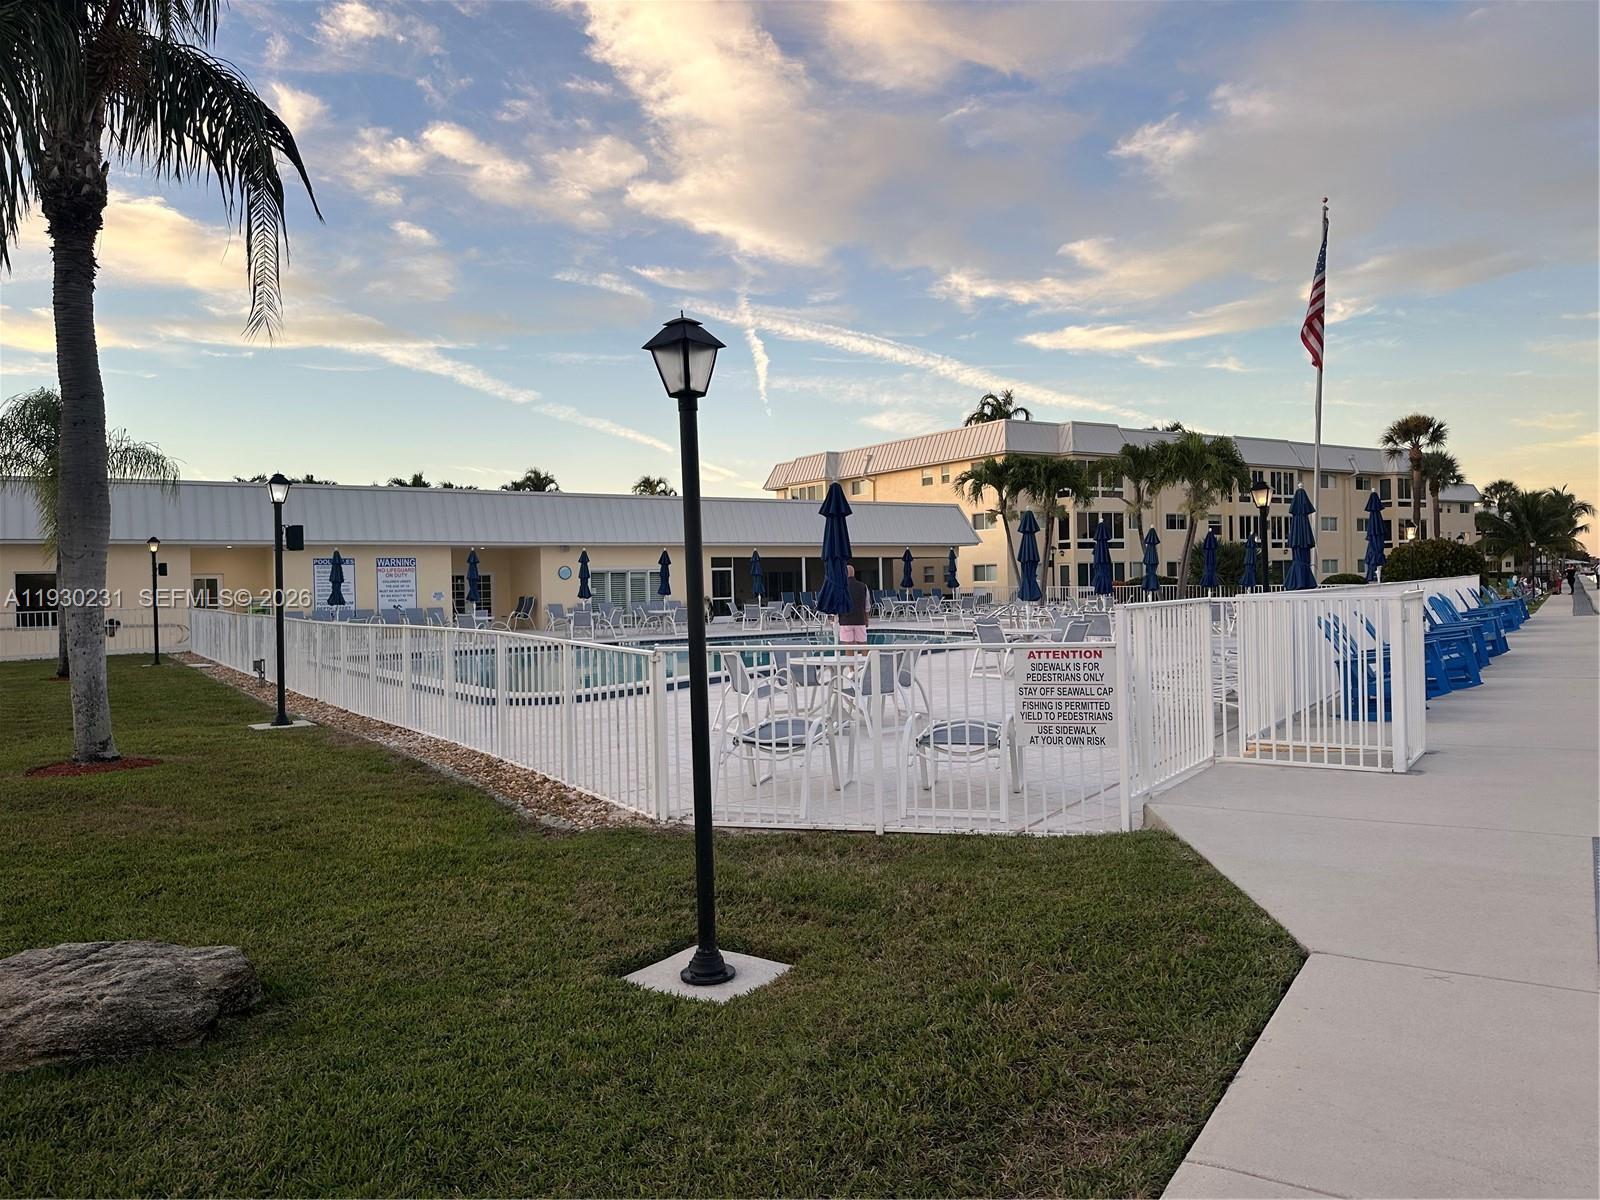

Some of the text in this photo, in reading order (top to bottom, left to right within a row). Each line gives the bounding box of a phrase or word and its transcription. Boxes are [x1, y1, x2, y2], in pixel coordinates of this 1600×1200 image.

[377, 558, 416, 567] WARNING
[1028, 650, 1102, 659] ATTENTION
[1030, 663, 1100, 671] SIDEWALK IS FOR
[1026, 673, 1104, 681] PEDESTRIANS ONLY
[1018, 687, 1114, 696] STAY OFF SEAWALL CAP
[1022, 702, 1110, 710] FISHING IS PERMITTED
[1020, 712, 1113, 721] YIELD TO PEDESTRIANS
[1037, 726, 1097, 735] USE SIDEWALK
[1029, 736, 1106, 745] AT YOUR OWN RISK
